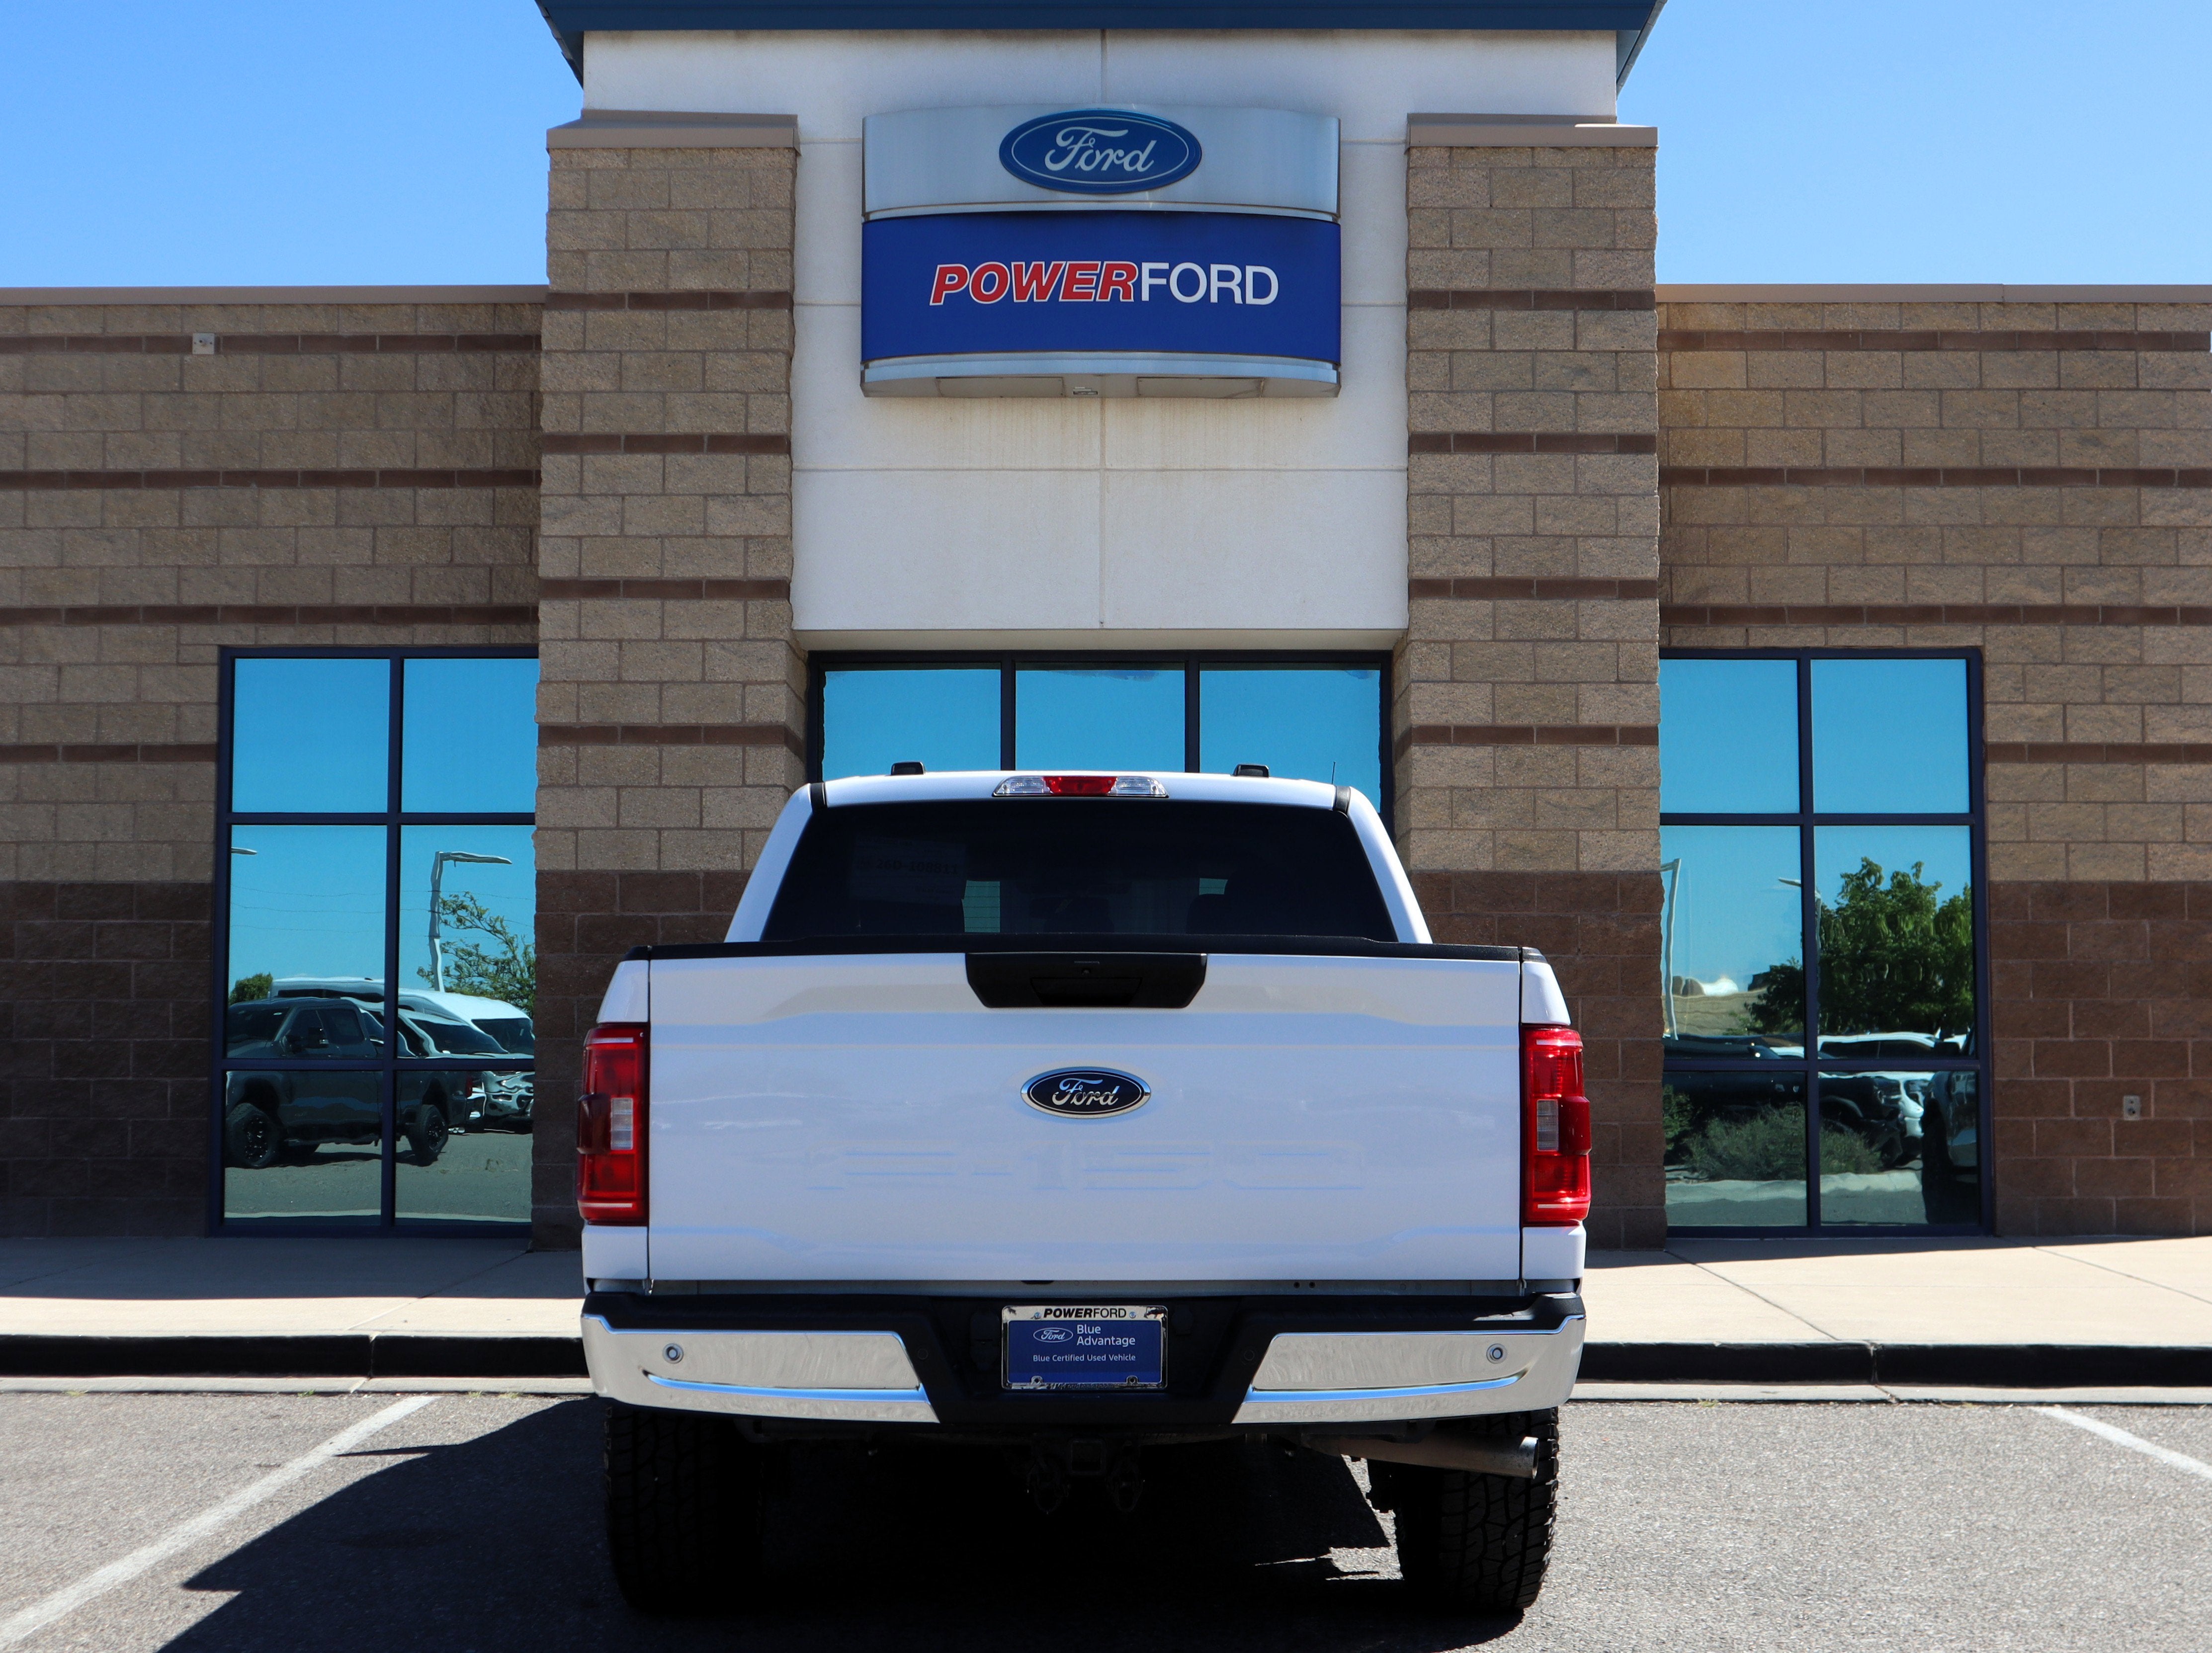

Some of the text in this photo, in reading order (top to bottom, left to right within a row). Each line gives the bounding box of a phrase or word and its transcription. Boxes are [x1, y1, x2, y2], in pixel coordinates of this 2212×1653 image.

[1044, 126, 1158, 172] Ford
[929, 260, 1278, 306] POWERFORD
[1052, 1077, 1120, 1106] Ford
[1043, 1308, 1127, 1318] POWERFORD
[1040, 1329, 1066, 1340] Ford
[1077, 1324, 1102, 1334] Blue
[1076, 1335, 1136, 1347] Advantage
